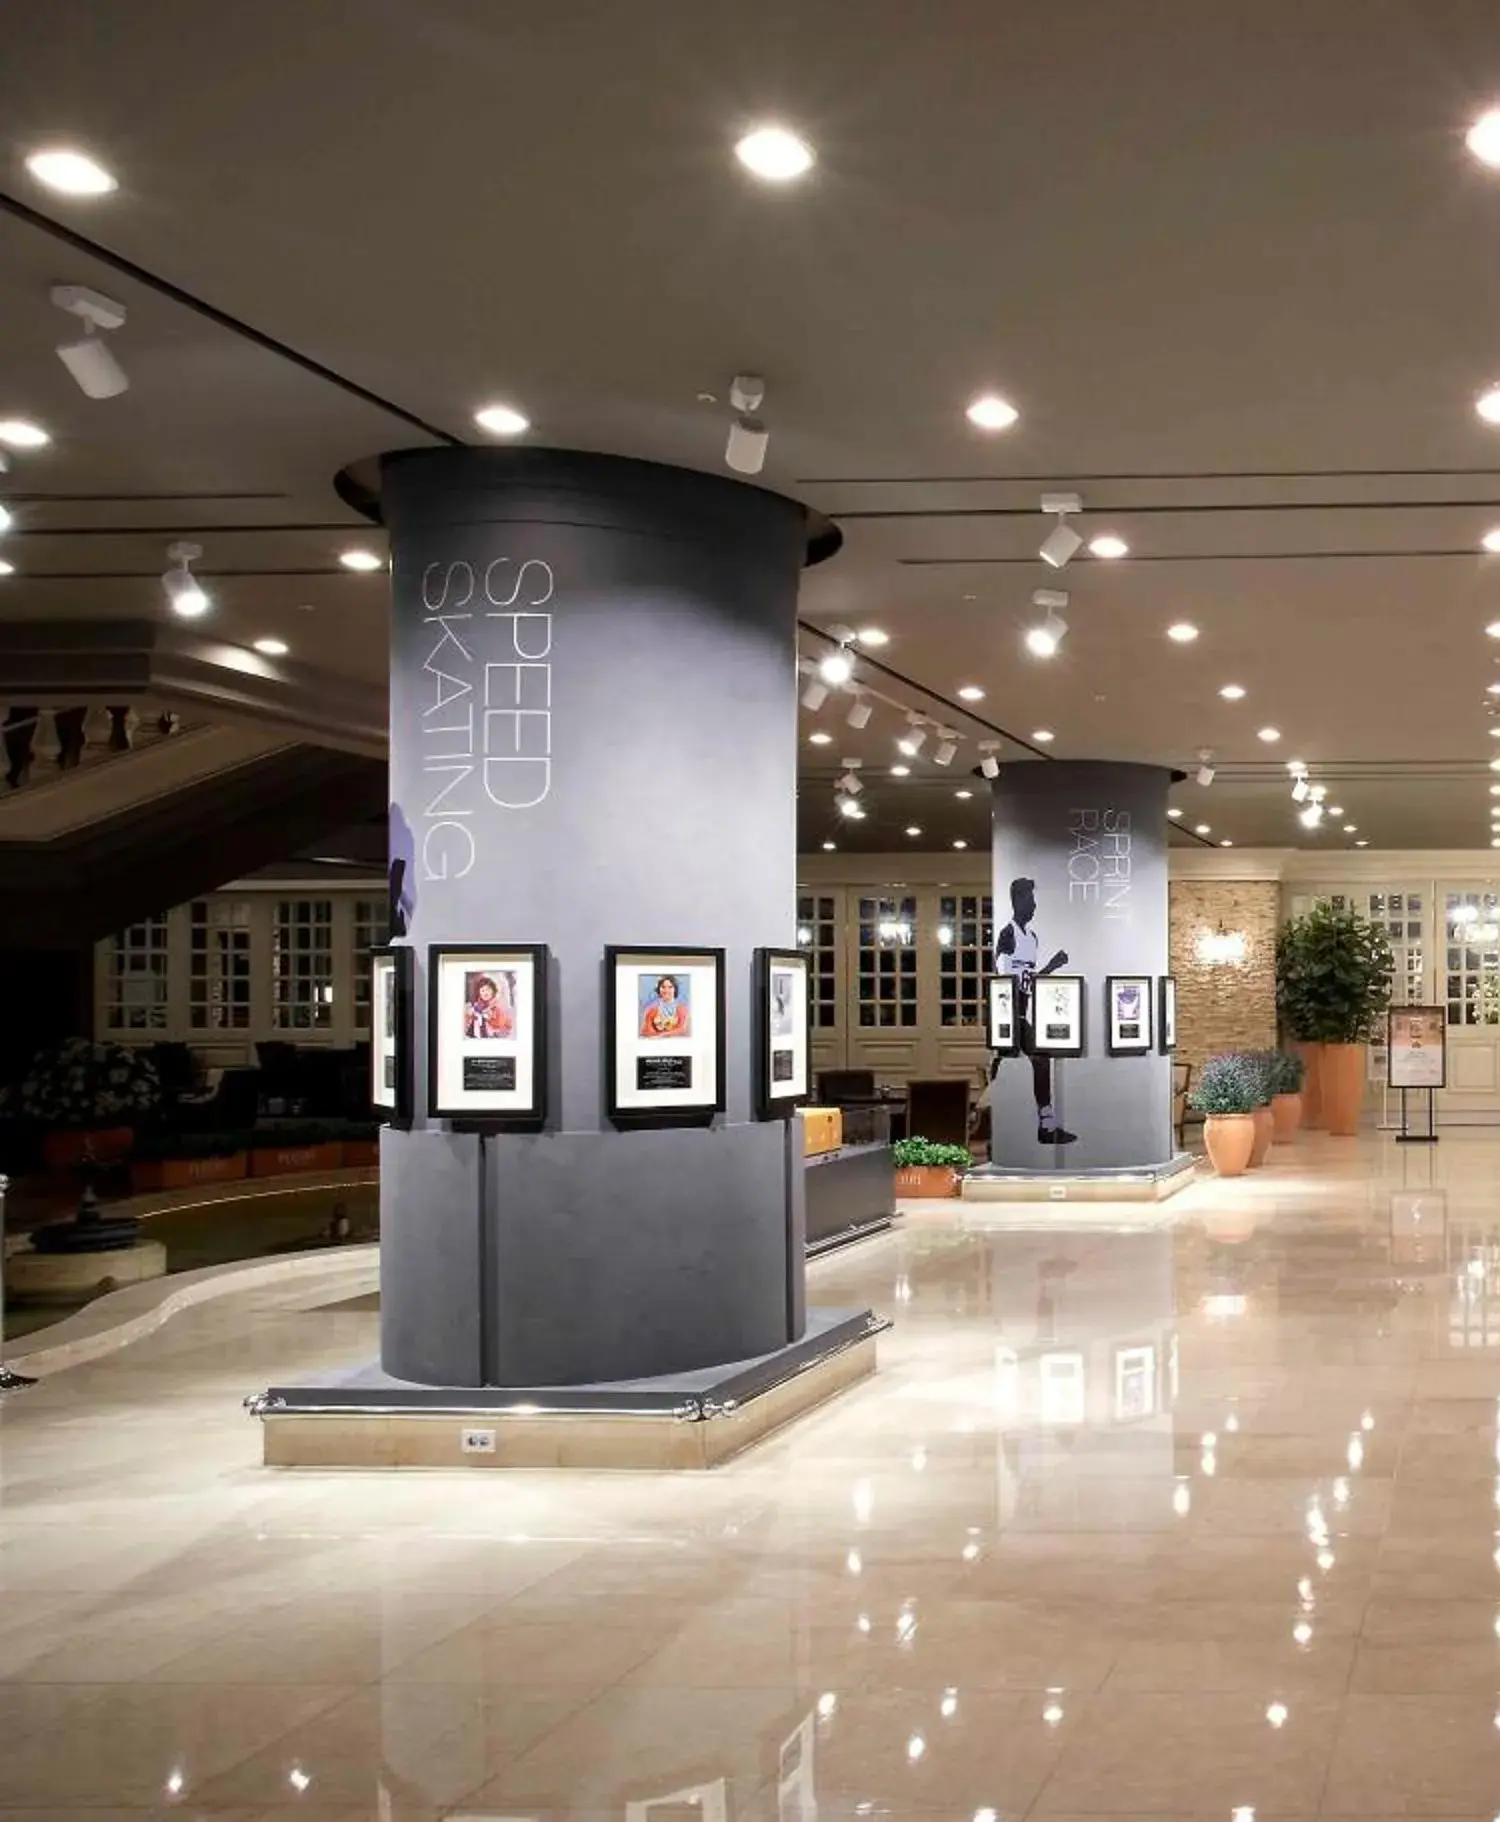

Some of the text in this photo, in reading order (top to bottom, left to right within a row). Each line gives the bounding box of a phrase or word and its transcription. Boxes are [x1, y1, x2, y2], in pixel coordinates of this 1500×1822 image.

[421, 559, 476, 882] SKATING
[484, 556, 554, 810] SPEED
[1067, 808, 1100, 904] RACE
[1102, 807, 1133, 926] SPRINT
